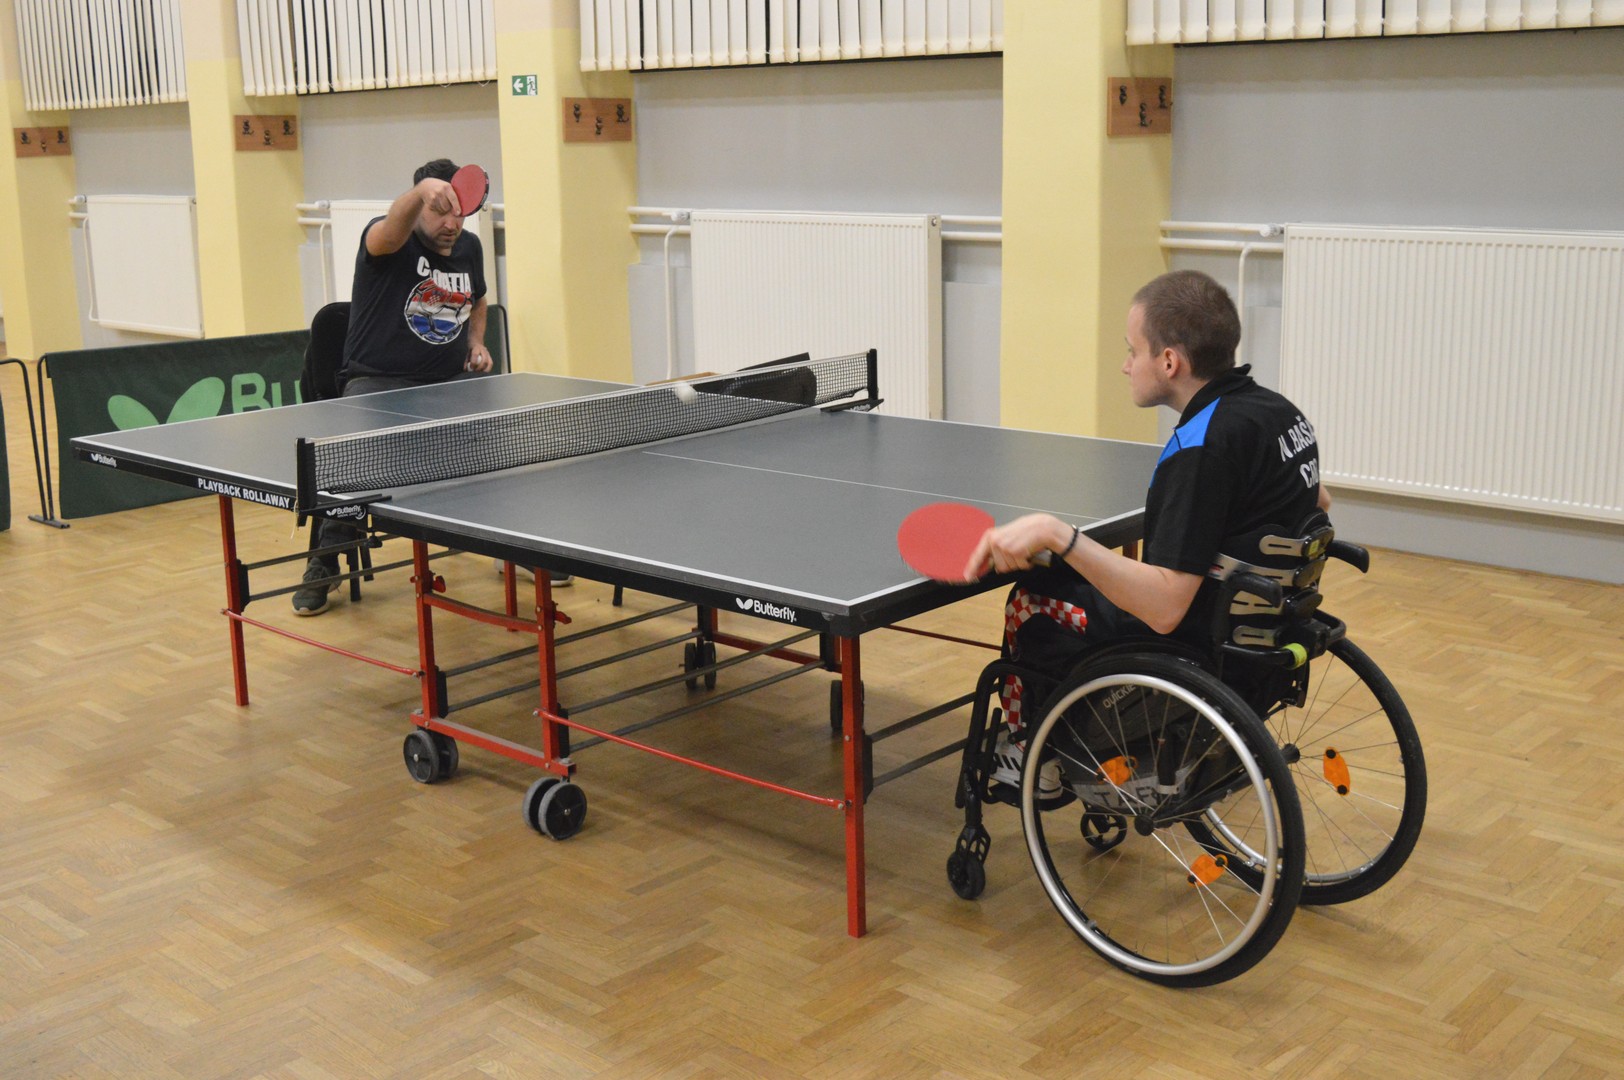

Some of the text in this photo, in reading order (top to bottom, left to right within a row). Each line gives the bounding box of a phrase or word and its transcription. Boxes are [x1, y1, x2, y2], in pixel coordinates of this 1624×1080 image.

[197, 478, 290, 508] PLAYBACK ROLLAWAY
[753, 599, 796, 623] Butterfly
